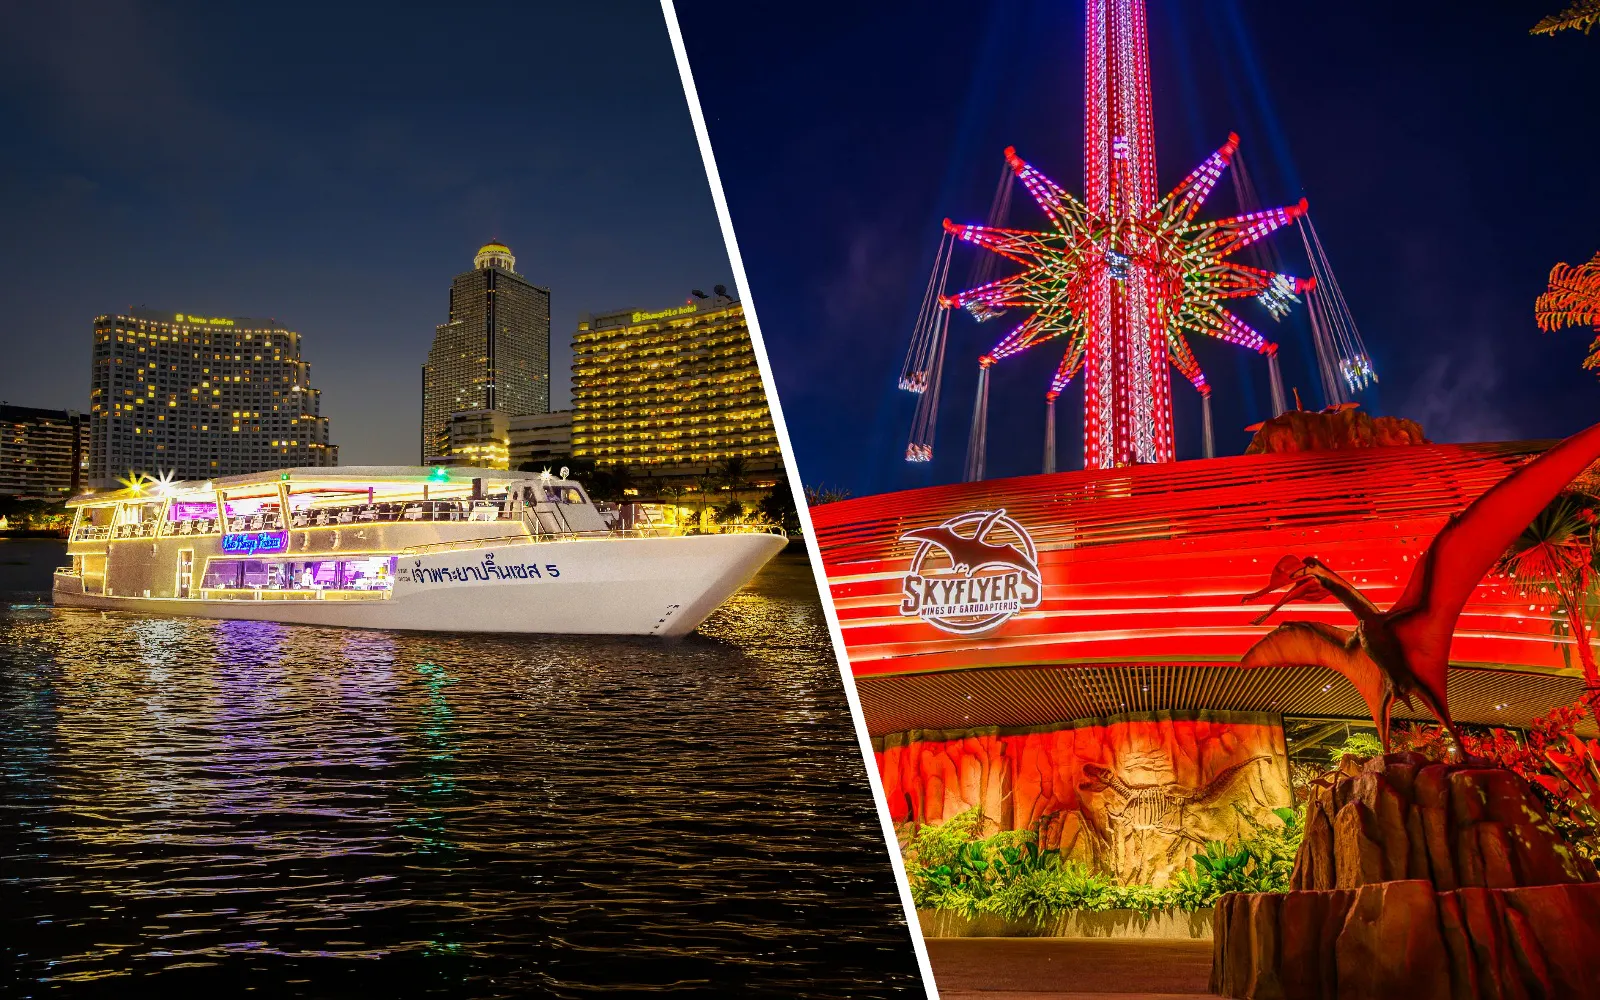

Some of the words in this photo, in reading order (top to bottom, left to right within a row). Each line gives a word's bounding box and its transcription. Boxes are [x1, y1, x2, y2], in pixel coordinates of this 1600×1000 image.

[545, 564, 561, 578] 5
[902, 570, 1040, 613] SKYFLYERS
[921, 606, 945, 616] WINGS
[947, 606, 957, 615] OF
[959, 601, 1018, 614] GARUDAPTERUS
